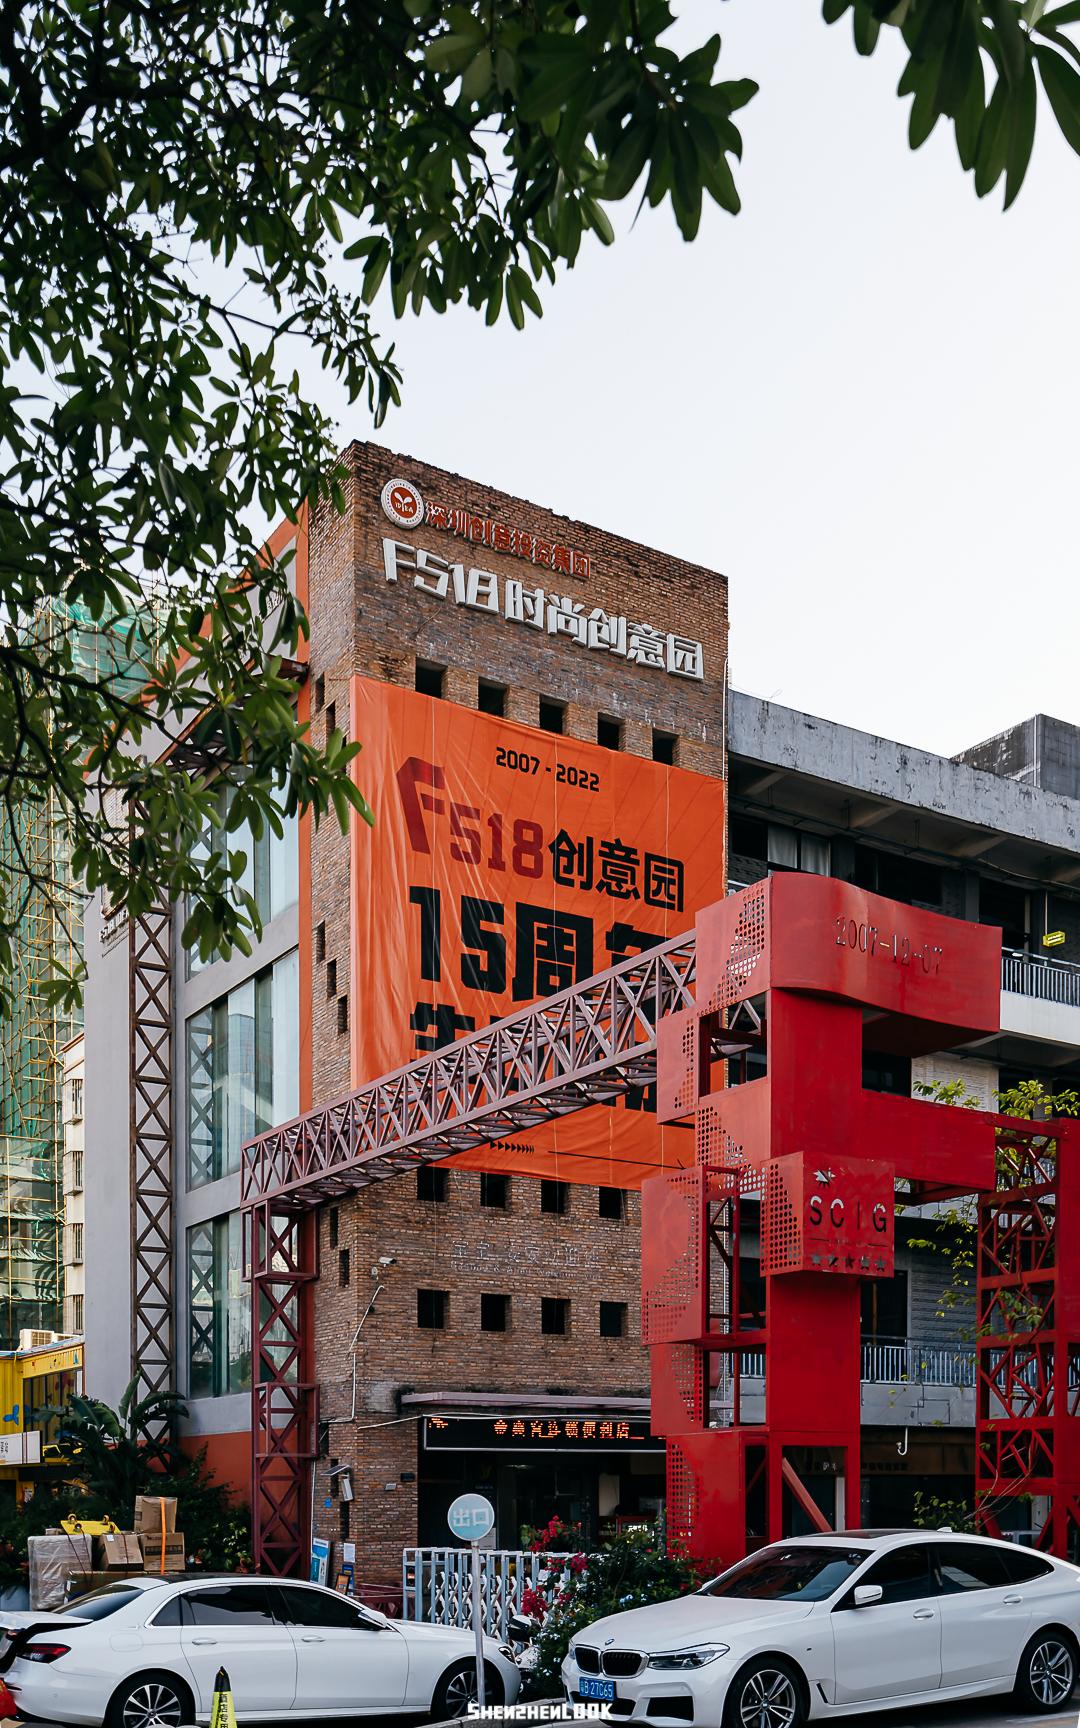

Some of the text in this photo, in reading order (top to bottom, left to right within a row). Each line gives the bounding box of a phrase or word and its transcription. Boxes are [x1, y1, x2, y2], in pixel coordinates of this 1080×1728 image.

[425, 501, 591, 579] 深圳创意投资集团
[809, 1195, 887, 1233] SCIG
[452, 1508, 490, 1527] 出口
